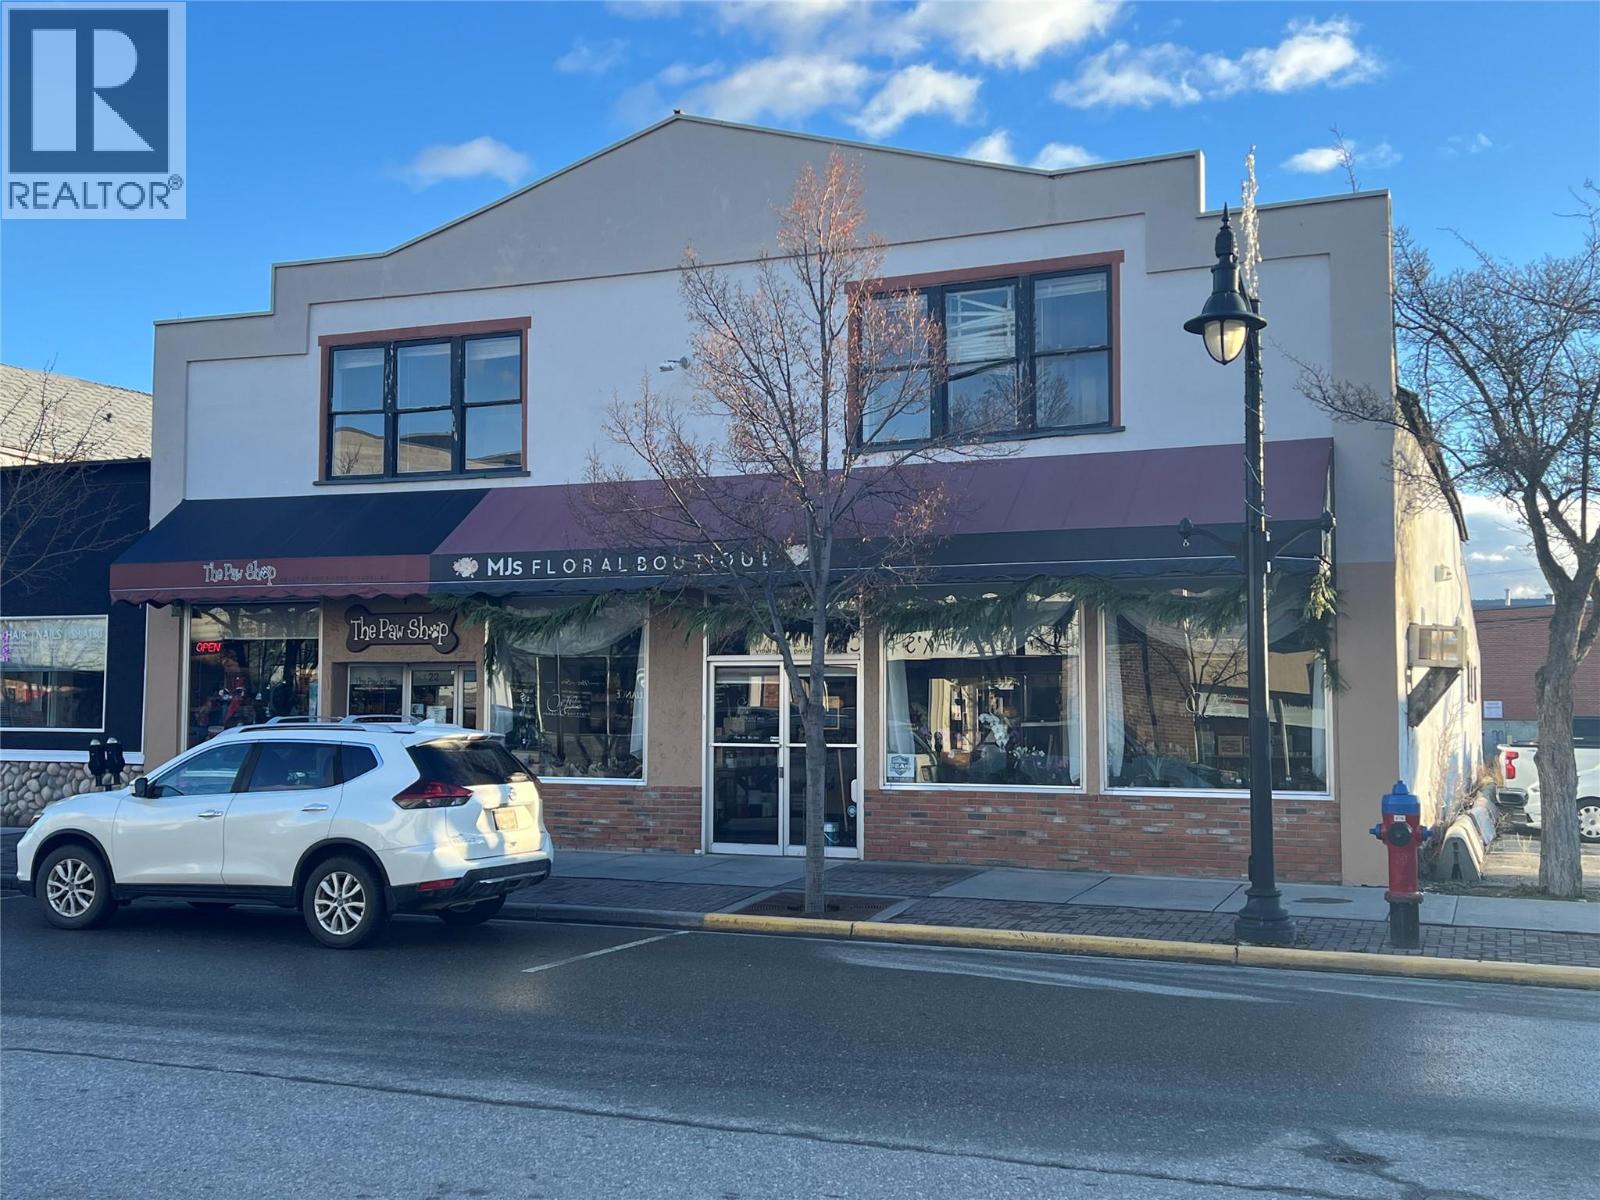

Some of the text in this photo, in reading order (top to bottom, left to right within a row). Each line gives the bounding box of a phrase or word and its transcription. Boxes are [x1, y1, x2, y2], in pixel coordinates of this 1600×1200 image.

[203, 560, 276, 586] The Paw Shop
[487, 557, 523, 576] MJs
[532, 557, 628, 575] FLORAL
[6, 629, 28, 640] HAIR
[36, 628, 62, 640] NAILS
[350, 616, 449, 645] The Paw Shop
[195, 642, 222, 653] OPEN
